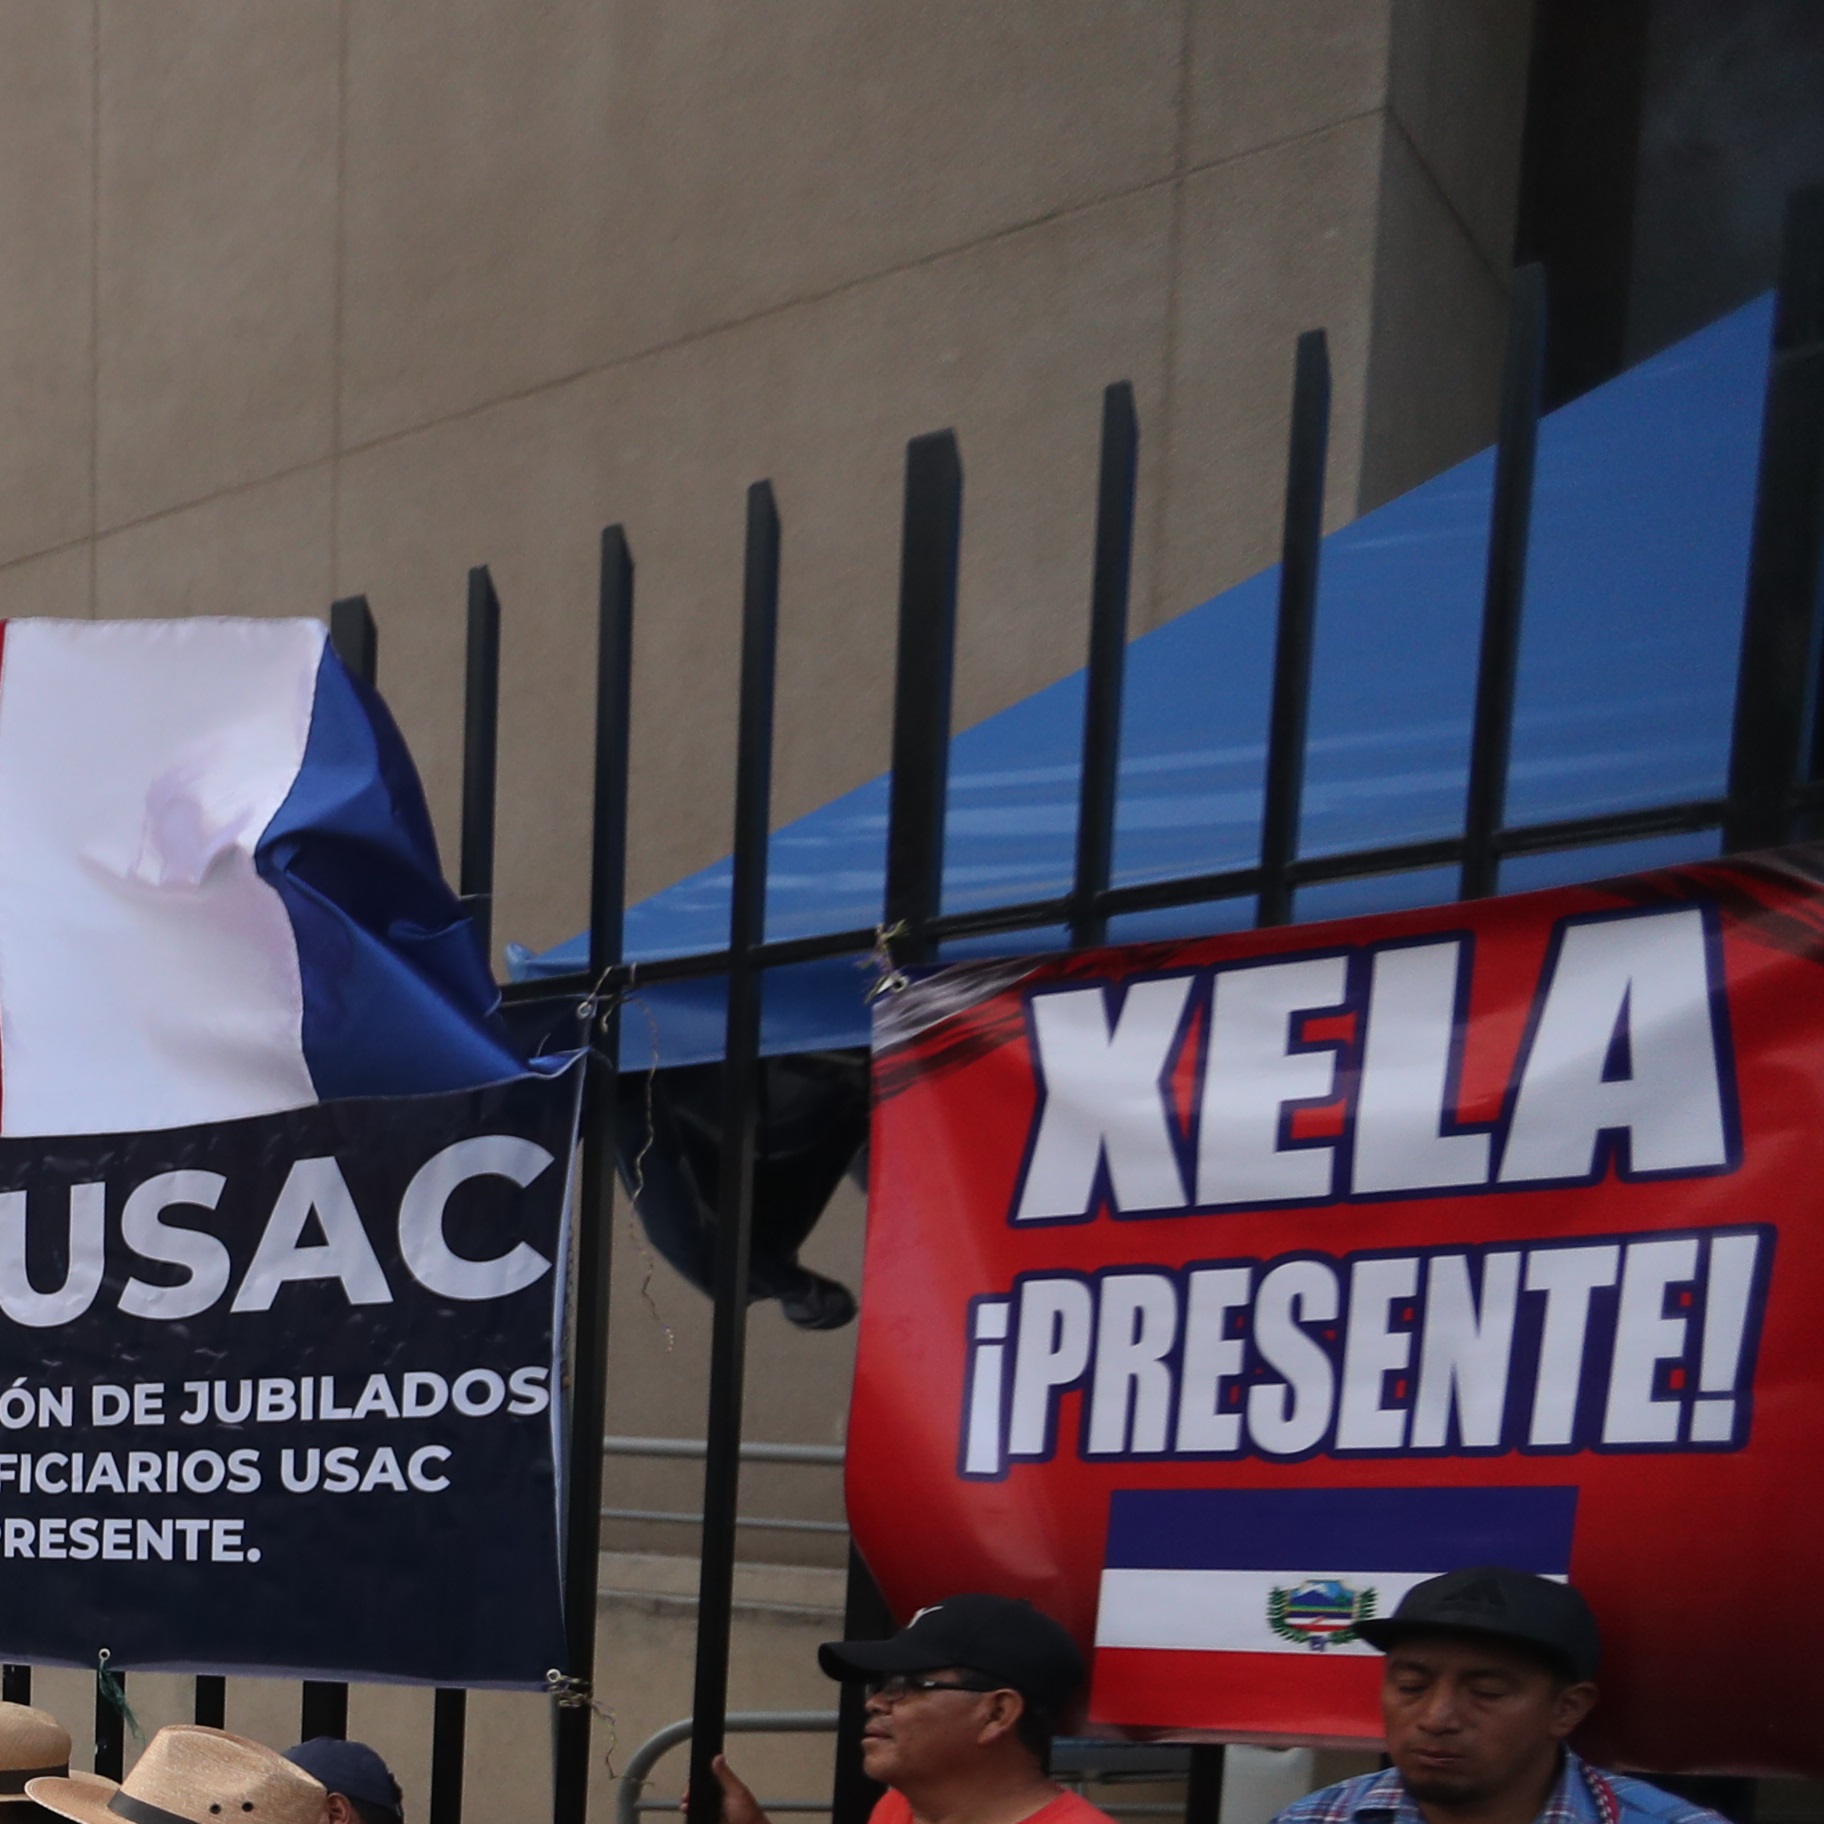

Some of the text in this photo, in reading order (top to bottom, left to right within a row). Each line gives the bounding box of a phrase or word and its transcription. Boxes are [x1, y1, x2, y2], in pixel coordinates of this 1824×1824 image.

[1012, 904, 1736, 1225] XELA
[91, 1383, 166, 1429] DE
[179, 1364, 551, 1427] JUBILADOS
[960, 1230, 1764, 1478] ¡PRESENTE!
[279, 1444, 452, 1493] USAC
